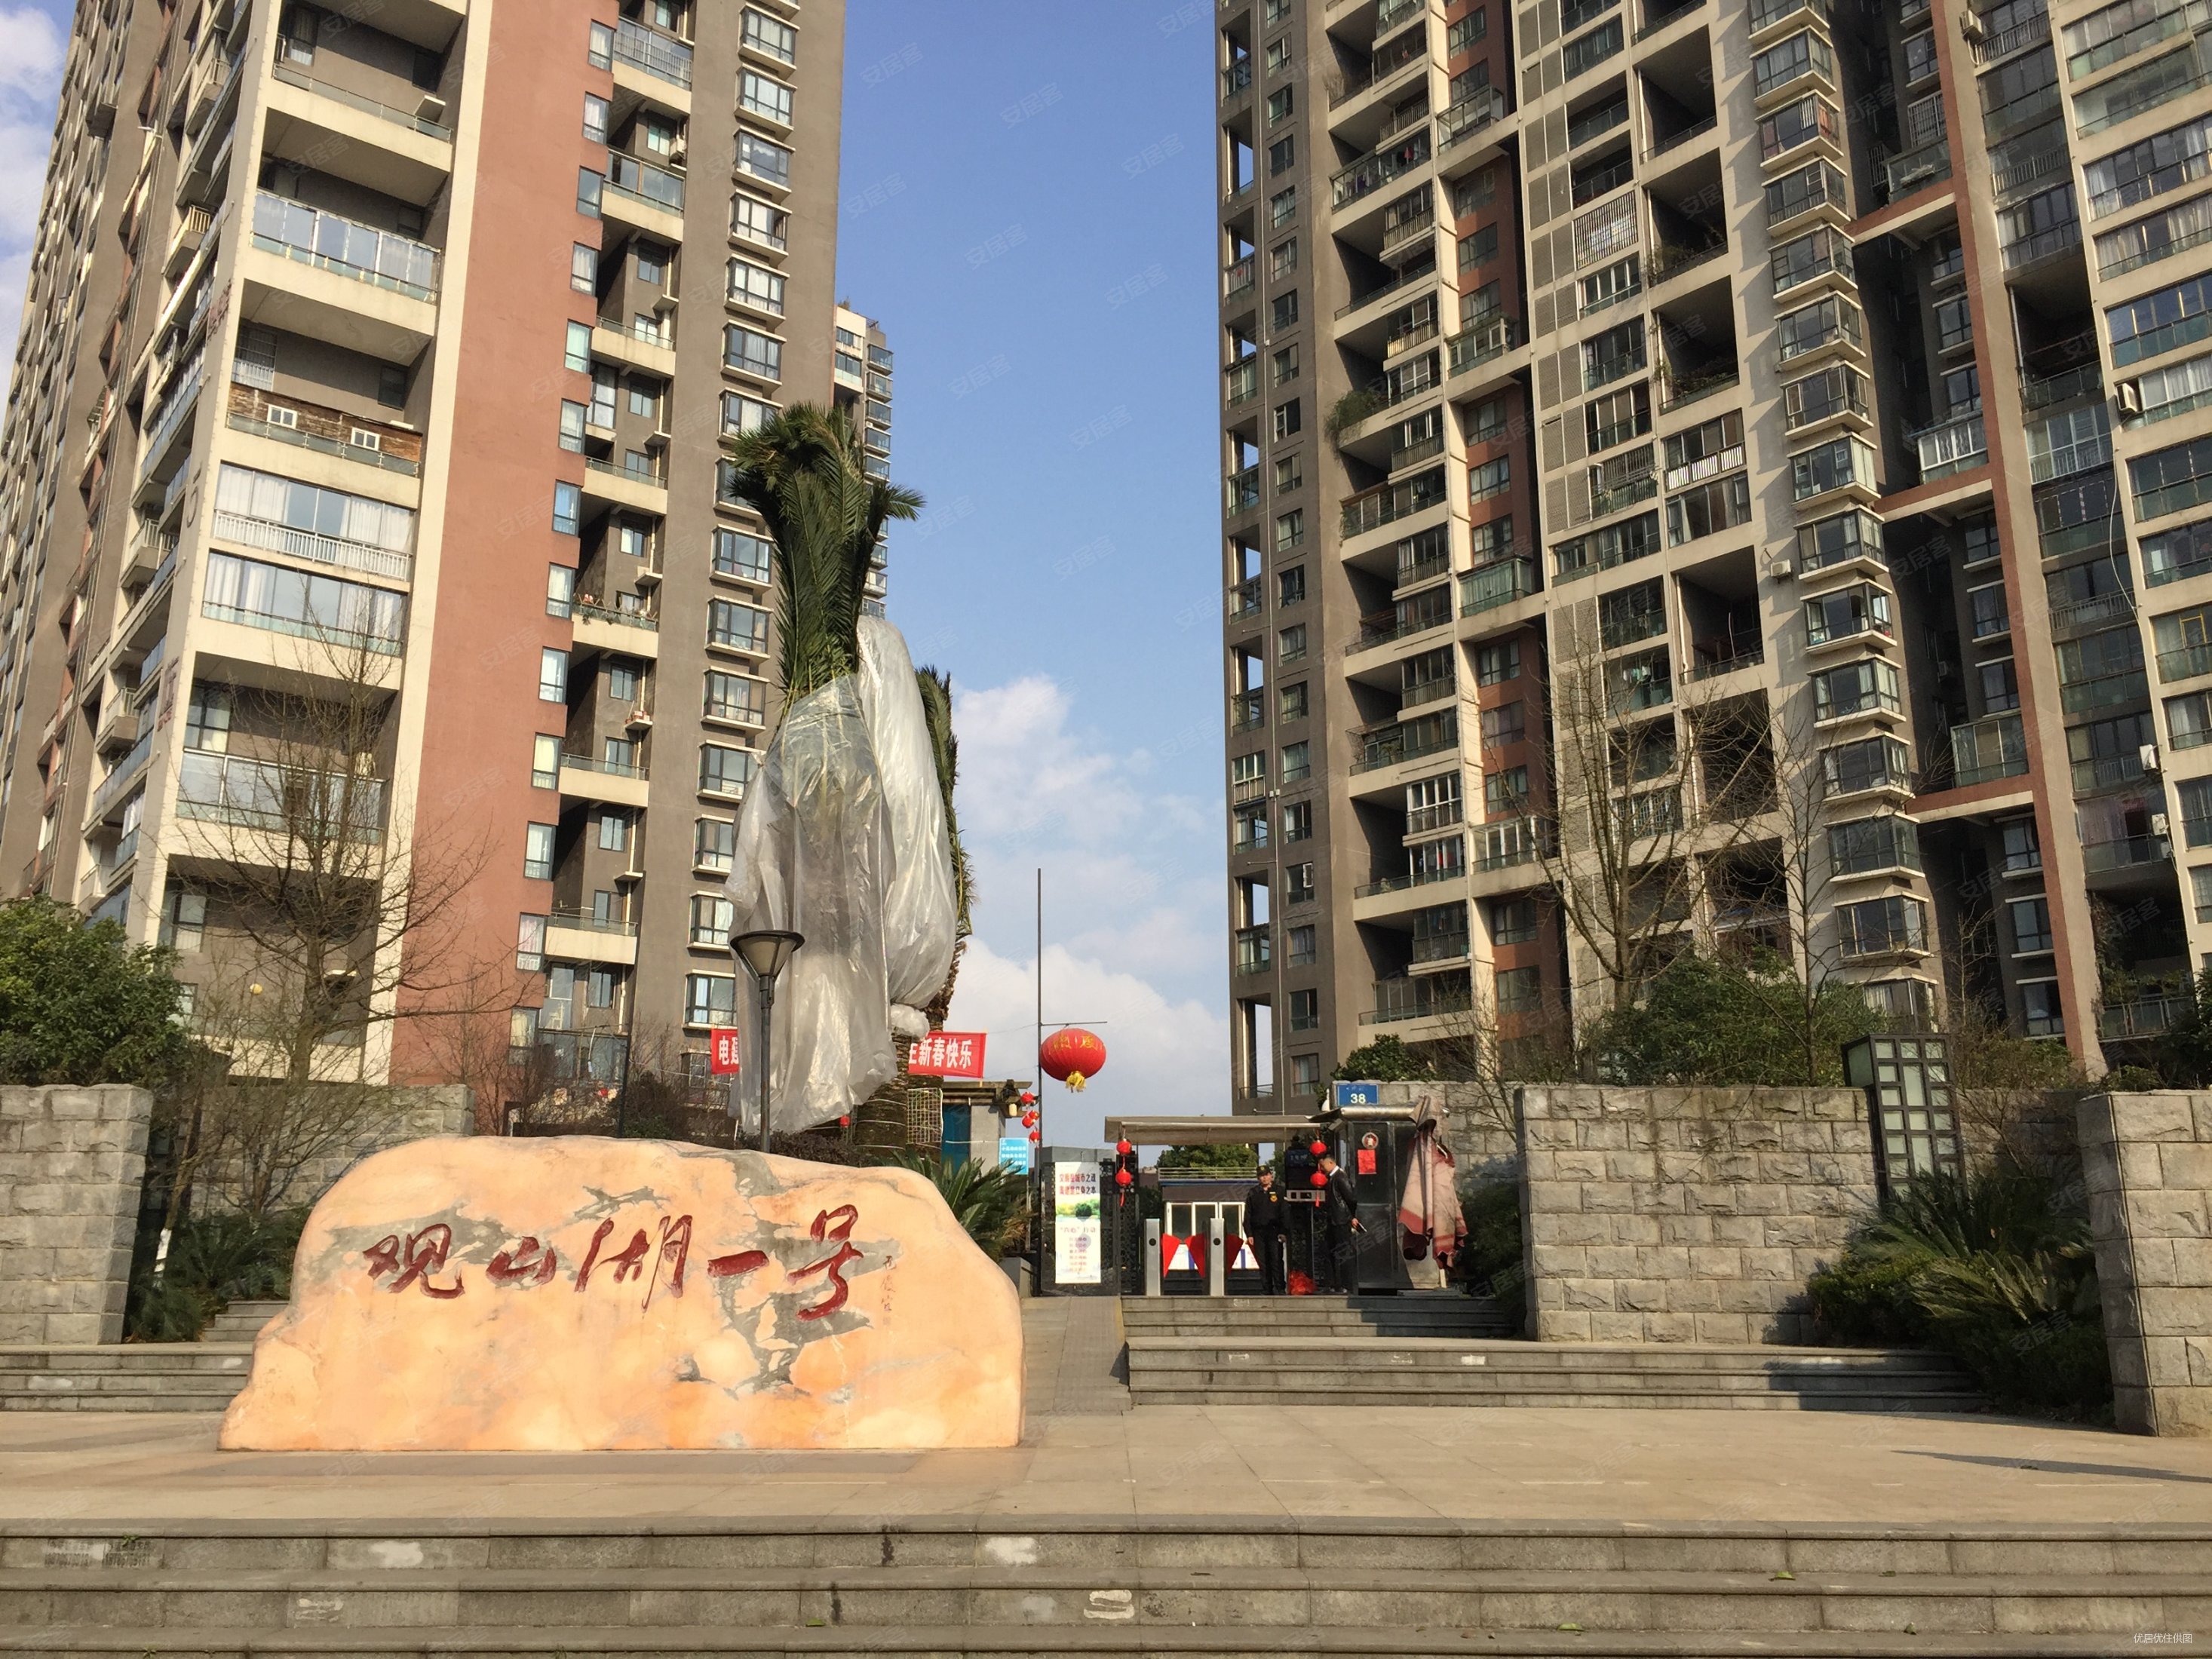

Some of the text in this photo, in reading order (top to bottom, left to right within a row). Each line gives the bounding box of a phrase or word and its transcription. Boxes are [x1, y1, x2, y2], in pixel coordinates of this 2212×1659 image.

[1350, 1093, 1366, 1105] 38
[363, 1204, 864, 1321] 观山湖一号
